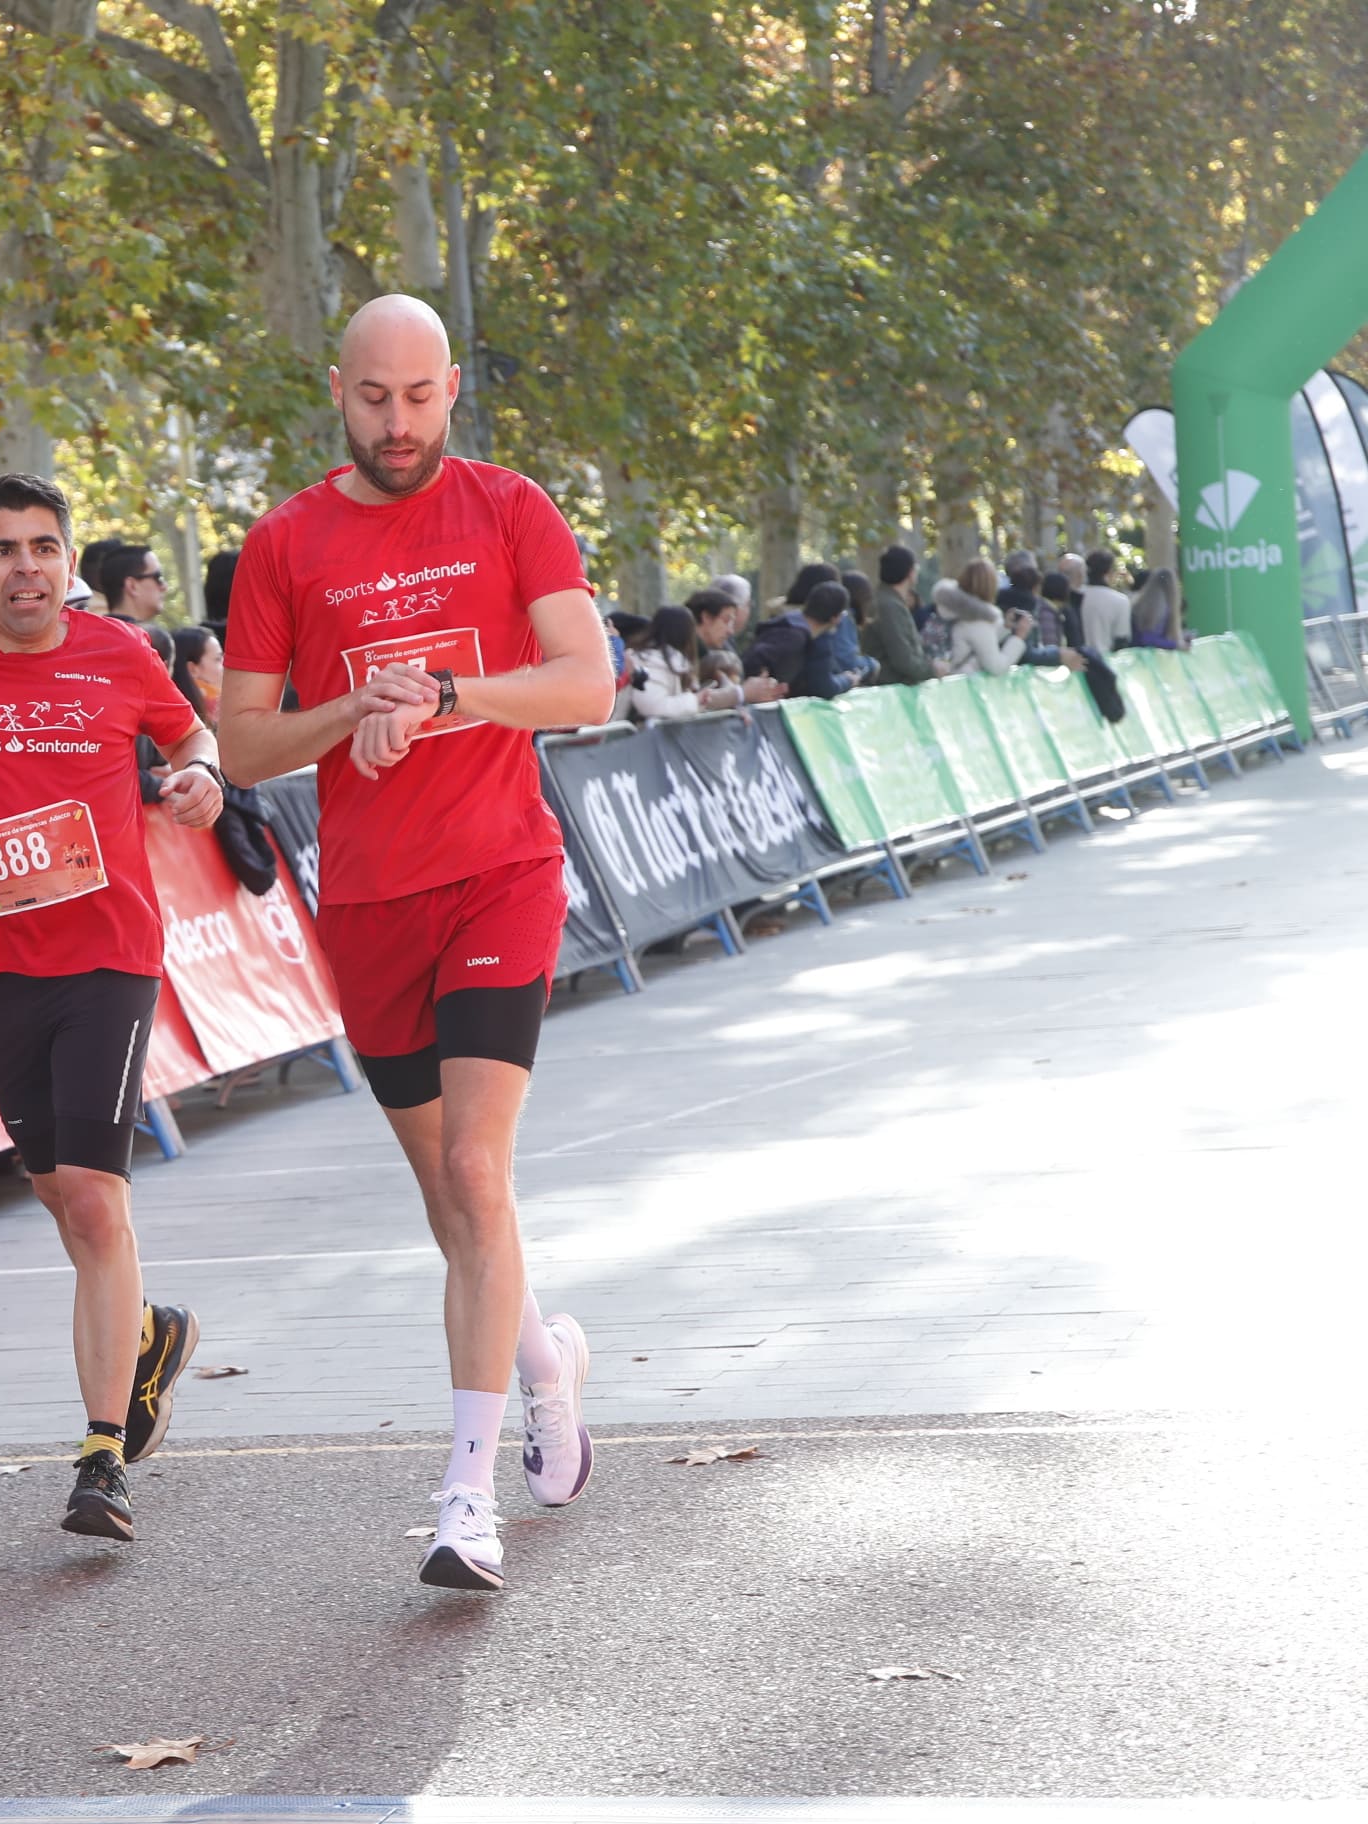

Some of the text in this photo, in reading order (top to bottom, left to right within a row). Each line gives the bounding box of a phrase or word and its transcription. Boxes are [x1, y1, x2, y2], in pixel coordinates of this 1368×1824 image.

[1184, 538, 1282, 574] Unicaja
[325, 561, 477, 607] Sports Santander
[373, 653, 393, 661] Carrera
[403, 645, 433, 656] empresas
[54, 672, 111, 685] Castilla y León
[26, 738, 102, 753] Santander
[164, 904, 239, 964] decco
